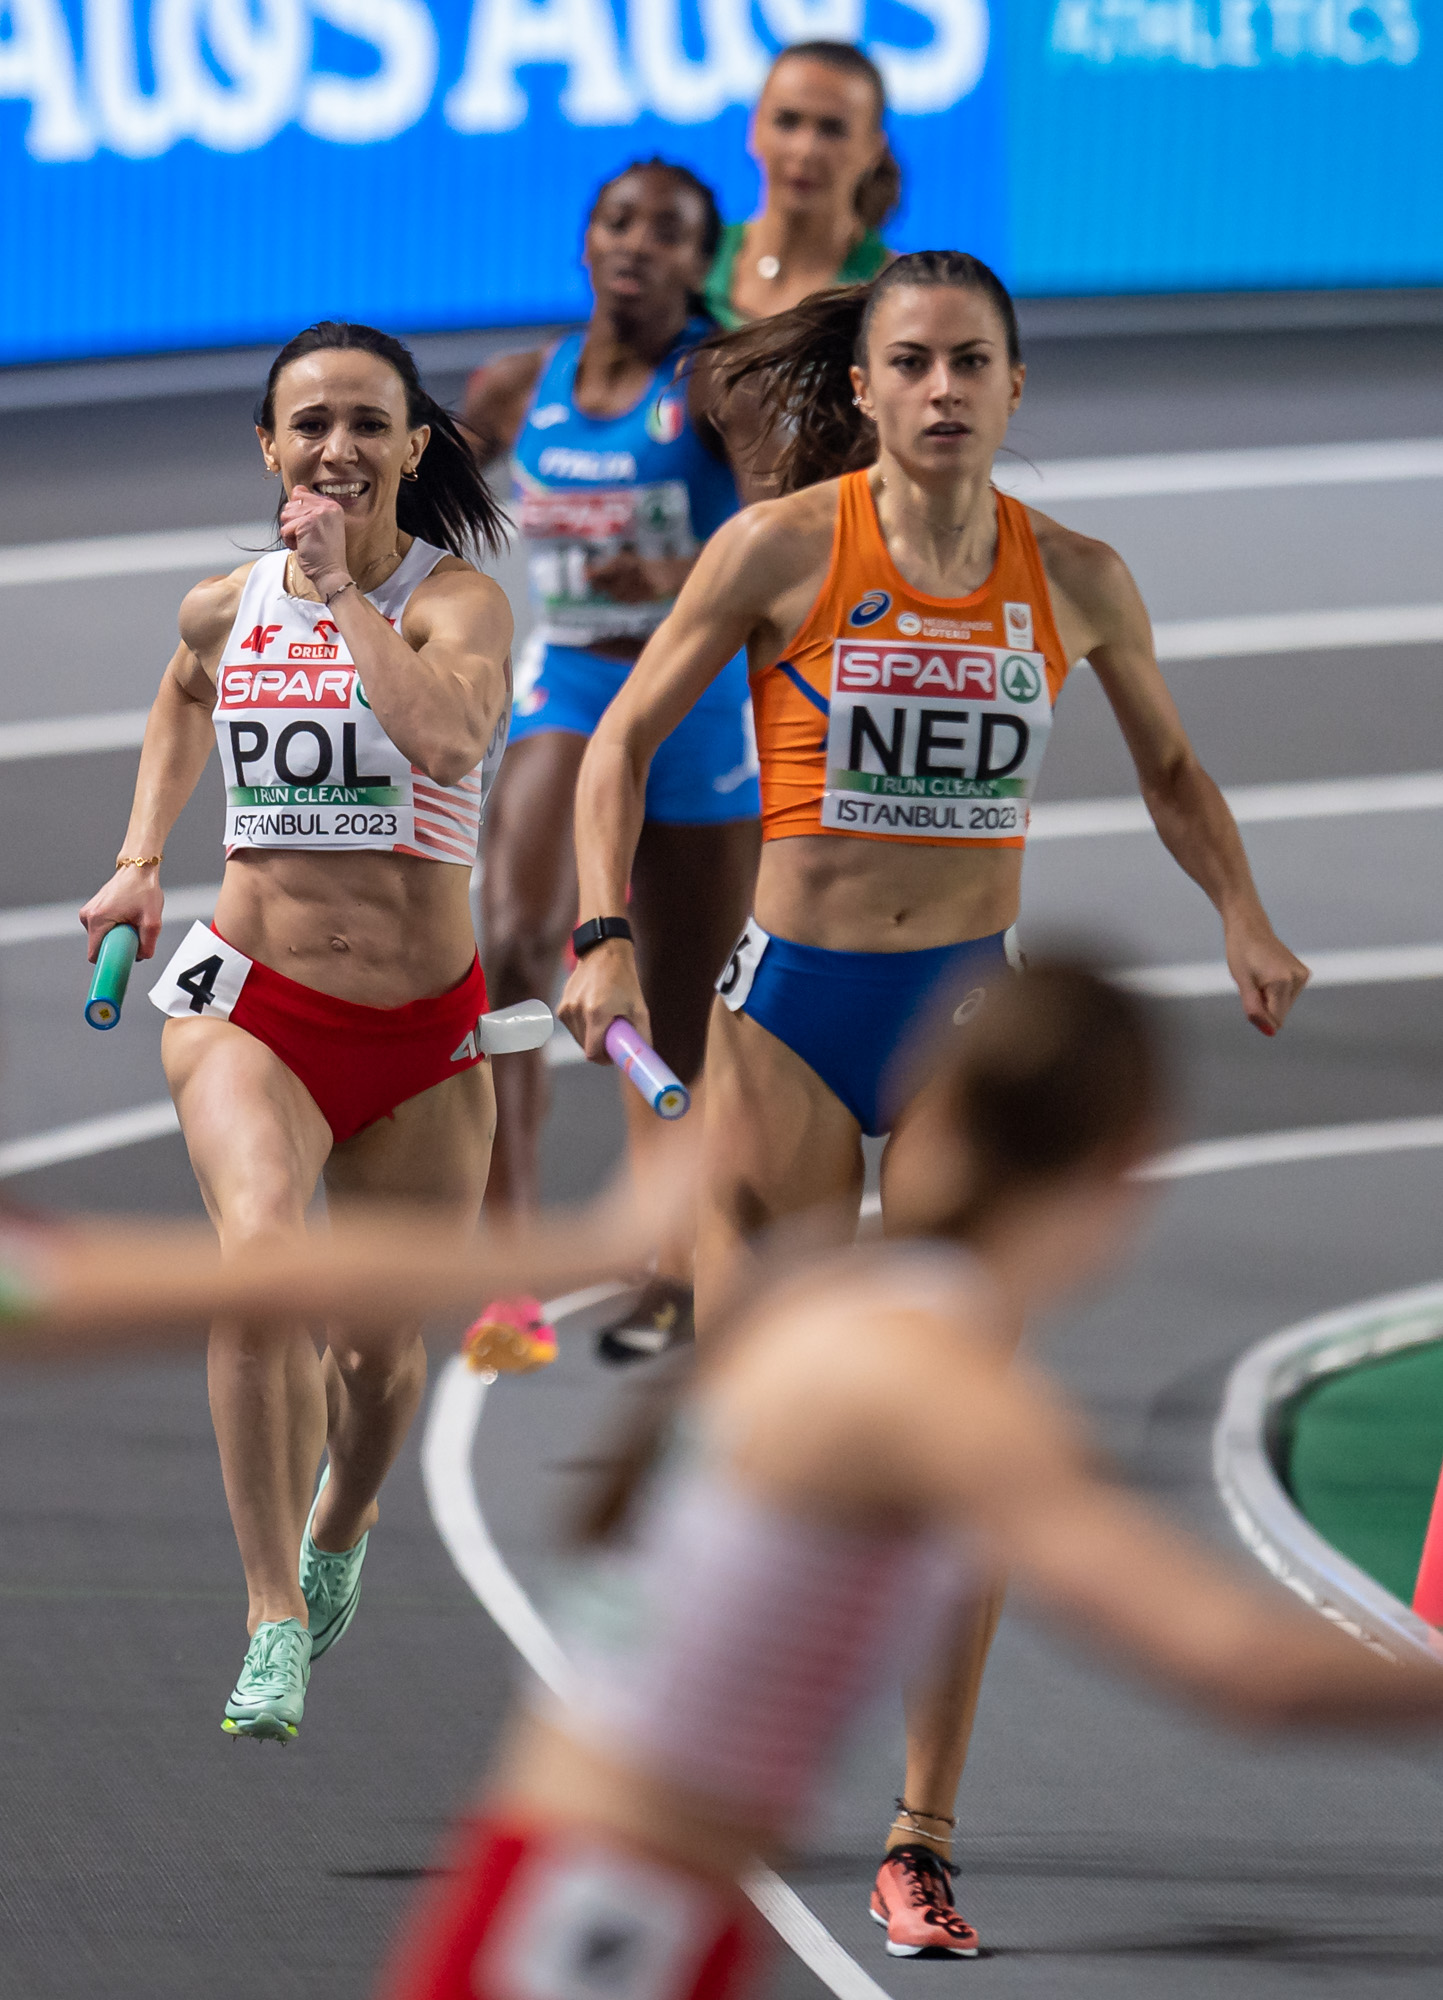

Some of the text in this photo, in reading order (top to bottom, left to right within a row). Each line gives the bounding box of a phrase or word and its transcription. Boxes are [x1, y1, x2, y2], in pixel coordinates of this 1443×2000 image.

[290, 645, 336, 658] ORLEN
[224, 670, 348, 704] SPAR
[841, 652, 994, 694] SPAR
[229, 720, 392, 787] POL
[848, 705, 1030, 781] NED
[253, 788, 259, 804] I
[260, 787, 290, 803] RUN
[871, 775, 878, 792] I
[883, 777, 926, 795] RUN
[234, 813, 398, 837] ISTANBUL 2023
[837, 799, 1018, 830] ISTANBUL 2023
[176, 954, 225, 1014] 4
